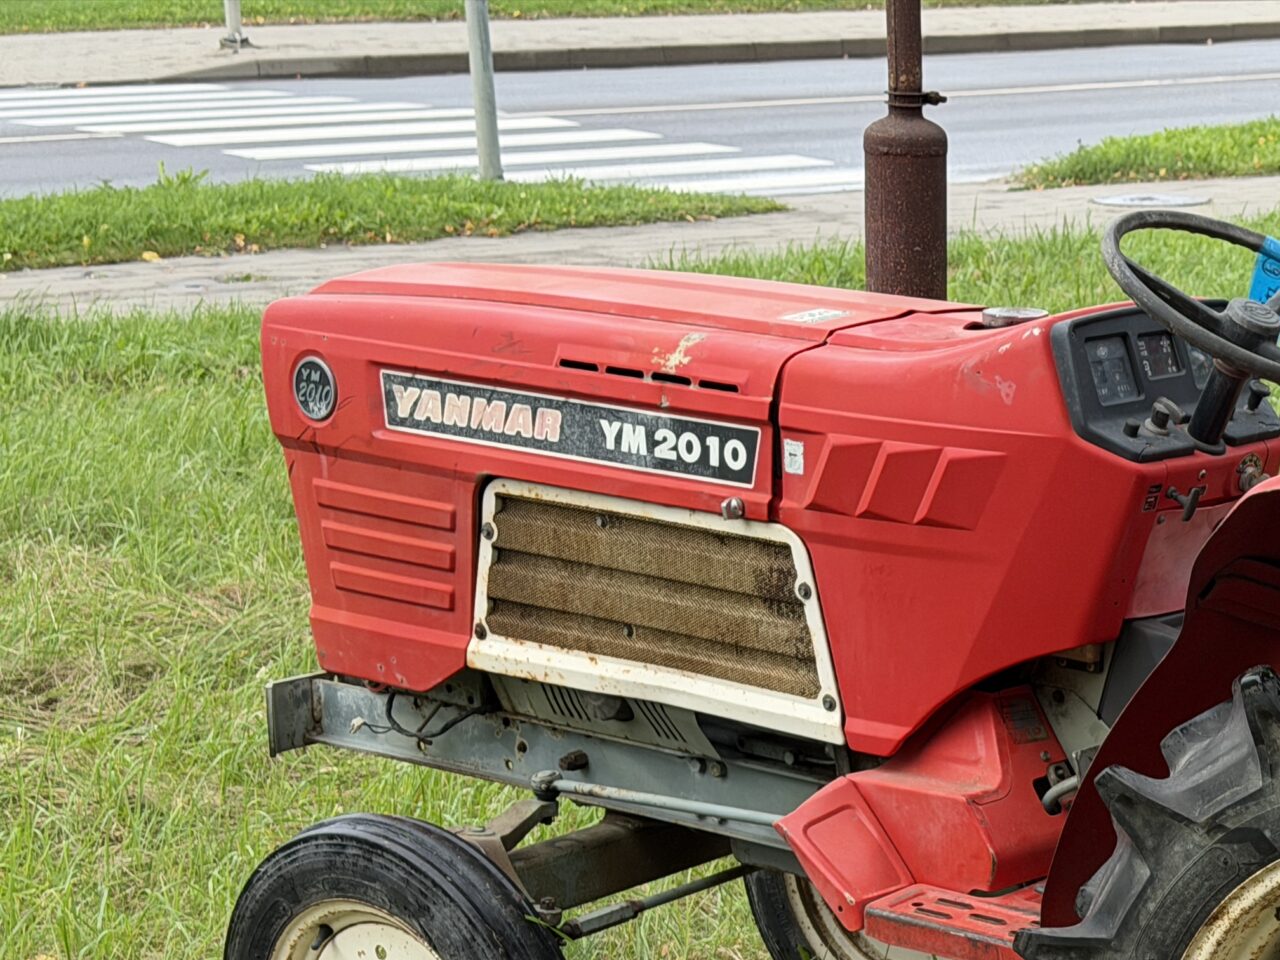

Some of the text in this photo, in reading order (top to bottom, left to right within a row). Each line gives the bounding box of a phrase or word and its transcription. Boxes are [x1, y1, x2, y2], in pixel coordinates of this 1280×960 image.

[301, 368, 321, 382] YM
[299, 382, 331, 408] 2010
[393, 384, 562, 443] YANMAR
